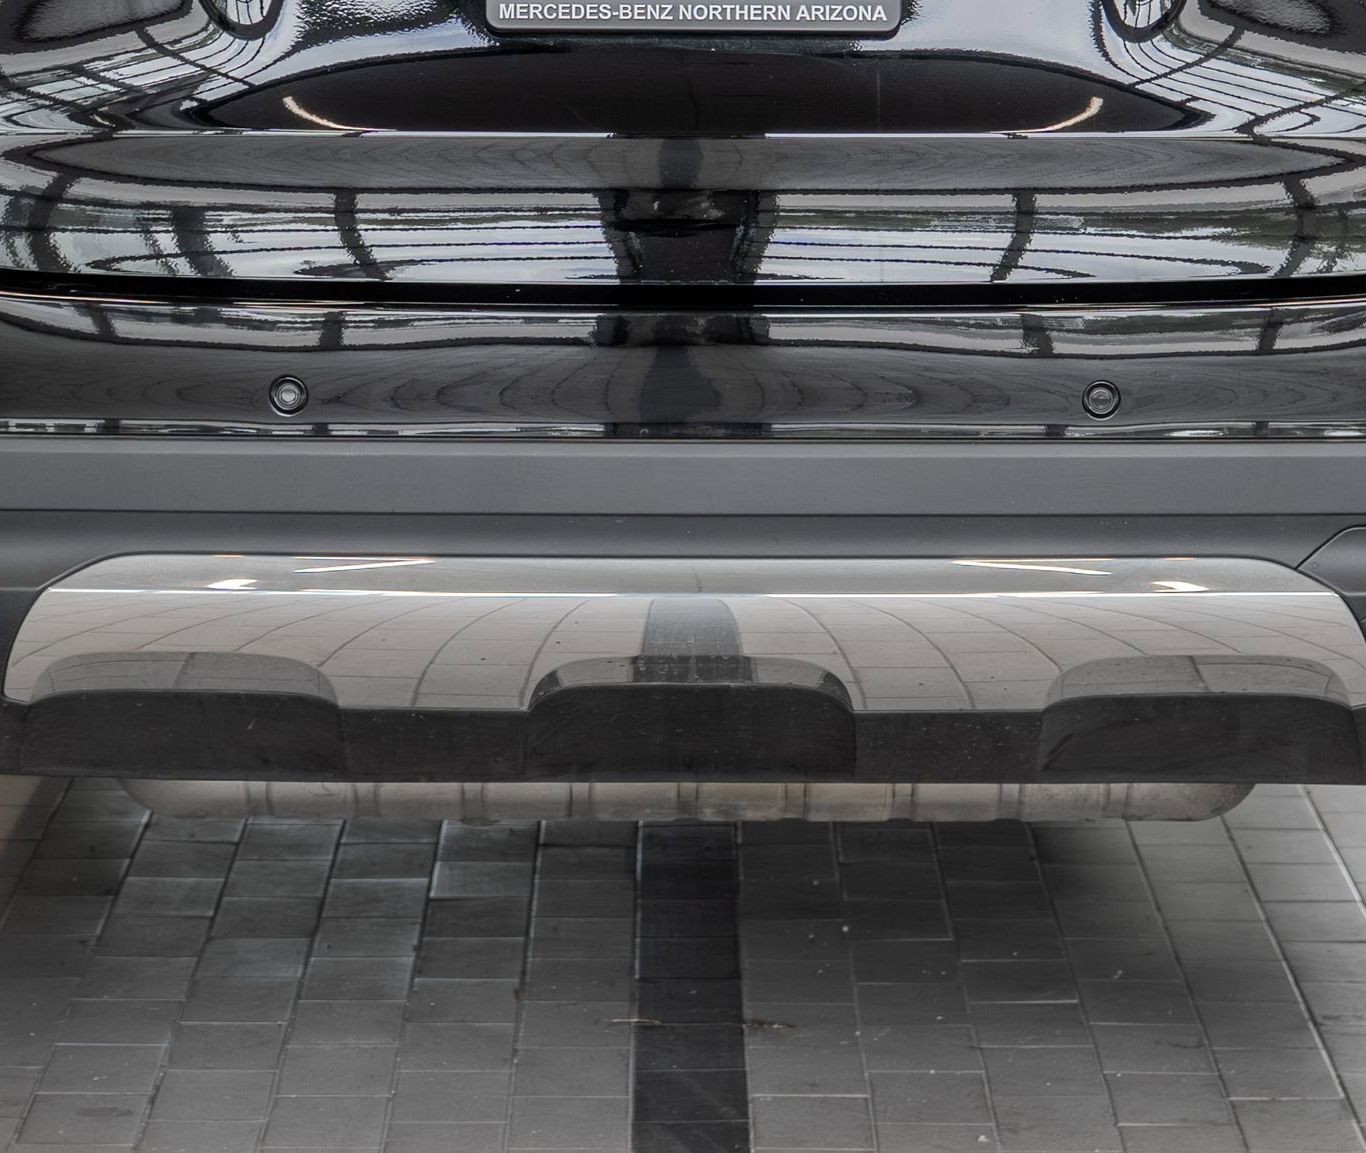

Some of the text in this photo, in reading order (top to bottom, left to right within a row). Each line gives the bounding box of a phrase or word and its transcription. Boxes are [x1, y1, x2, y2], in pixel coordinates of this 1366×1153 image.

[498, 2, 888, 22] MERCEDES-BENZ NORTHERN ARIZONA
